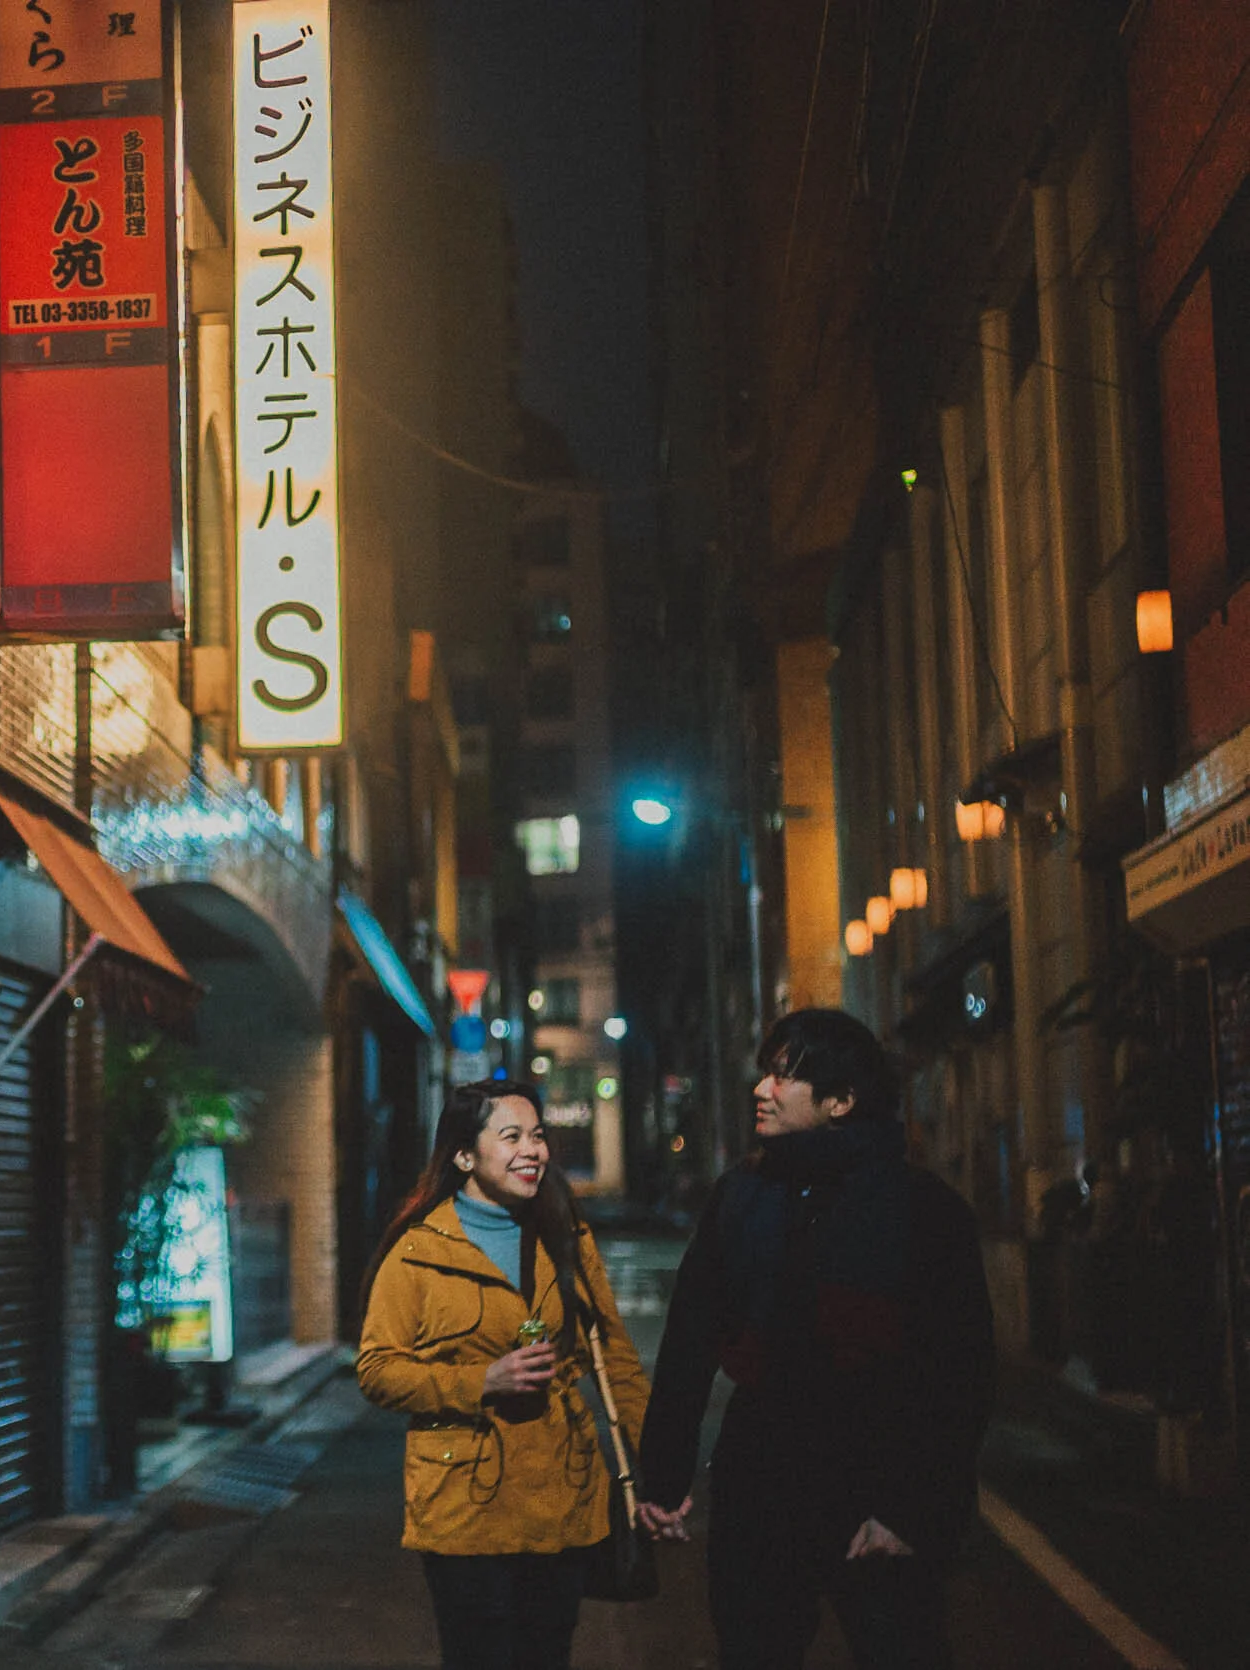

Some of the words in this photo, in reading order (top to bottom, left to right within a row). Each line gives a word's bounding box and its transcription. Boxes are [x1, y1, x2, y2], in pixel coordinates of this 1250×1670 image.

[51, 136, 104, 290] とん苑
[13, 304, 38, 325] TEL
[41, 298, 151, 323] 03-3358-1837
